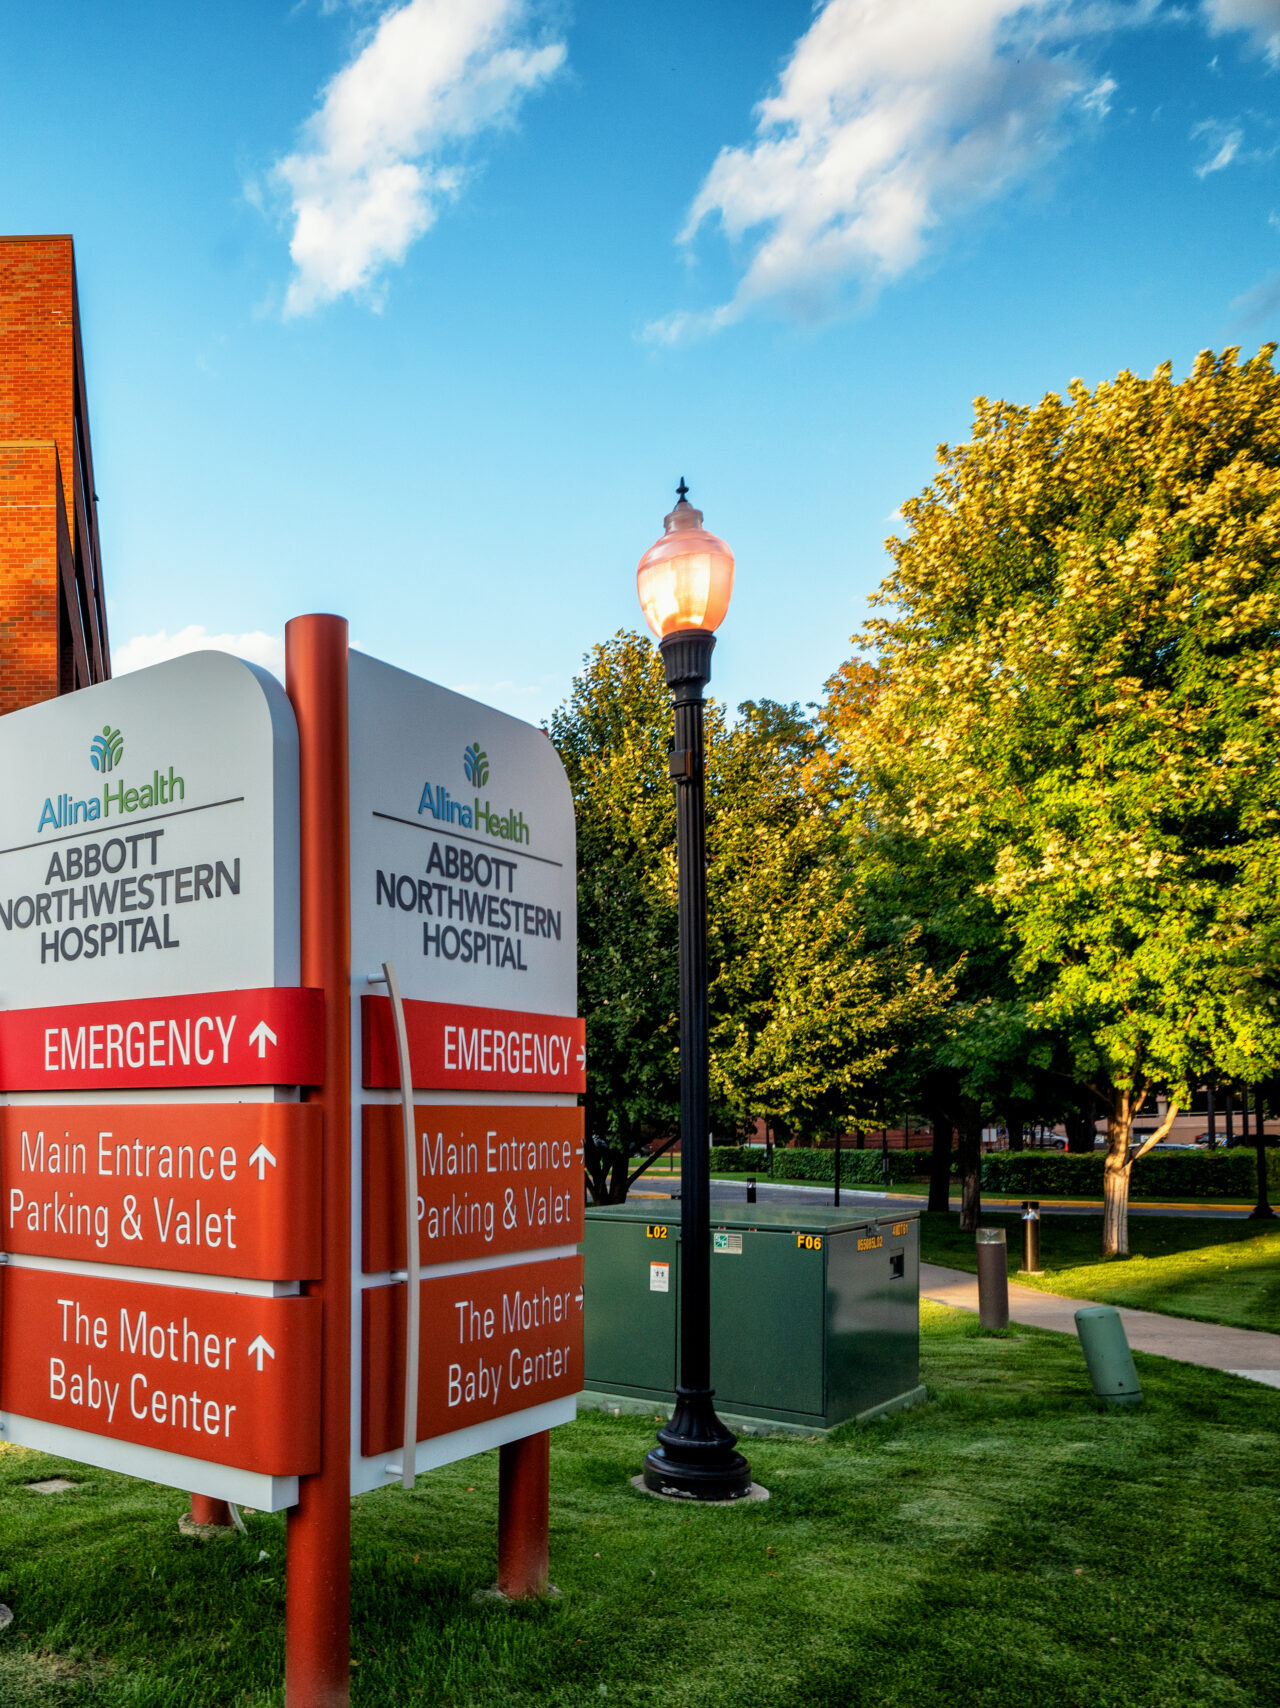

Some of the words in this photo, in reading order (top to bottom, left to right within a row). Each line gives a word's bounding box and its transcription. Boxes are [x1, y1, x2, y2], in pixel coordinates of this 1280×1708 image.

[37, 793, 100, 833] Allina
[103, 766, 185, 817] Health
[418, 781, 473, 829] Allina
[474, 797, 530, 845] Health
[45, 829, 164, 885] ABBOTT
[425, 842, 517, 893] ABBOTT
[376, 869, 561, 941] NORTHWESTERN
[40, 913, 180, 964] HOSPITAL
[423, 921, 527, 971] HOSPITAL
[44, 1015, 237, 1071] EMERGENCY
[444, 1025, 571, 1076] EMERGENCY
[21, 1131, 86, 1175] Main
[98, 1131, 237, 1181] Entrance
[422, 1131, 478, 1176] Main
[486, 1130, 572, 1173] Entrance
[10, 1188, 109, 1248] Parking
[120, 1194, 143, 1241] &
[153, 1197, 237, 1249] Valet
[502, 1187, 518, 1230] &
[524, 1185, 571, 1227] Valet
[646, 1225, 668, 1239] L02
[797, 1235, 822, 1250] F06
[57, 1299, 108, 1349] The
[120, 1308, 237, 1370] Mother
[454, 1300, 495, 1344] The
[502, 1286, 571, 1334] Mother
[50, 1357, 120, 1423] Baby
[130, 1373, 237, 1438] Center
[448, 1357, 503, 1408] Baby
[509, 1345, 570, 1390] Center
